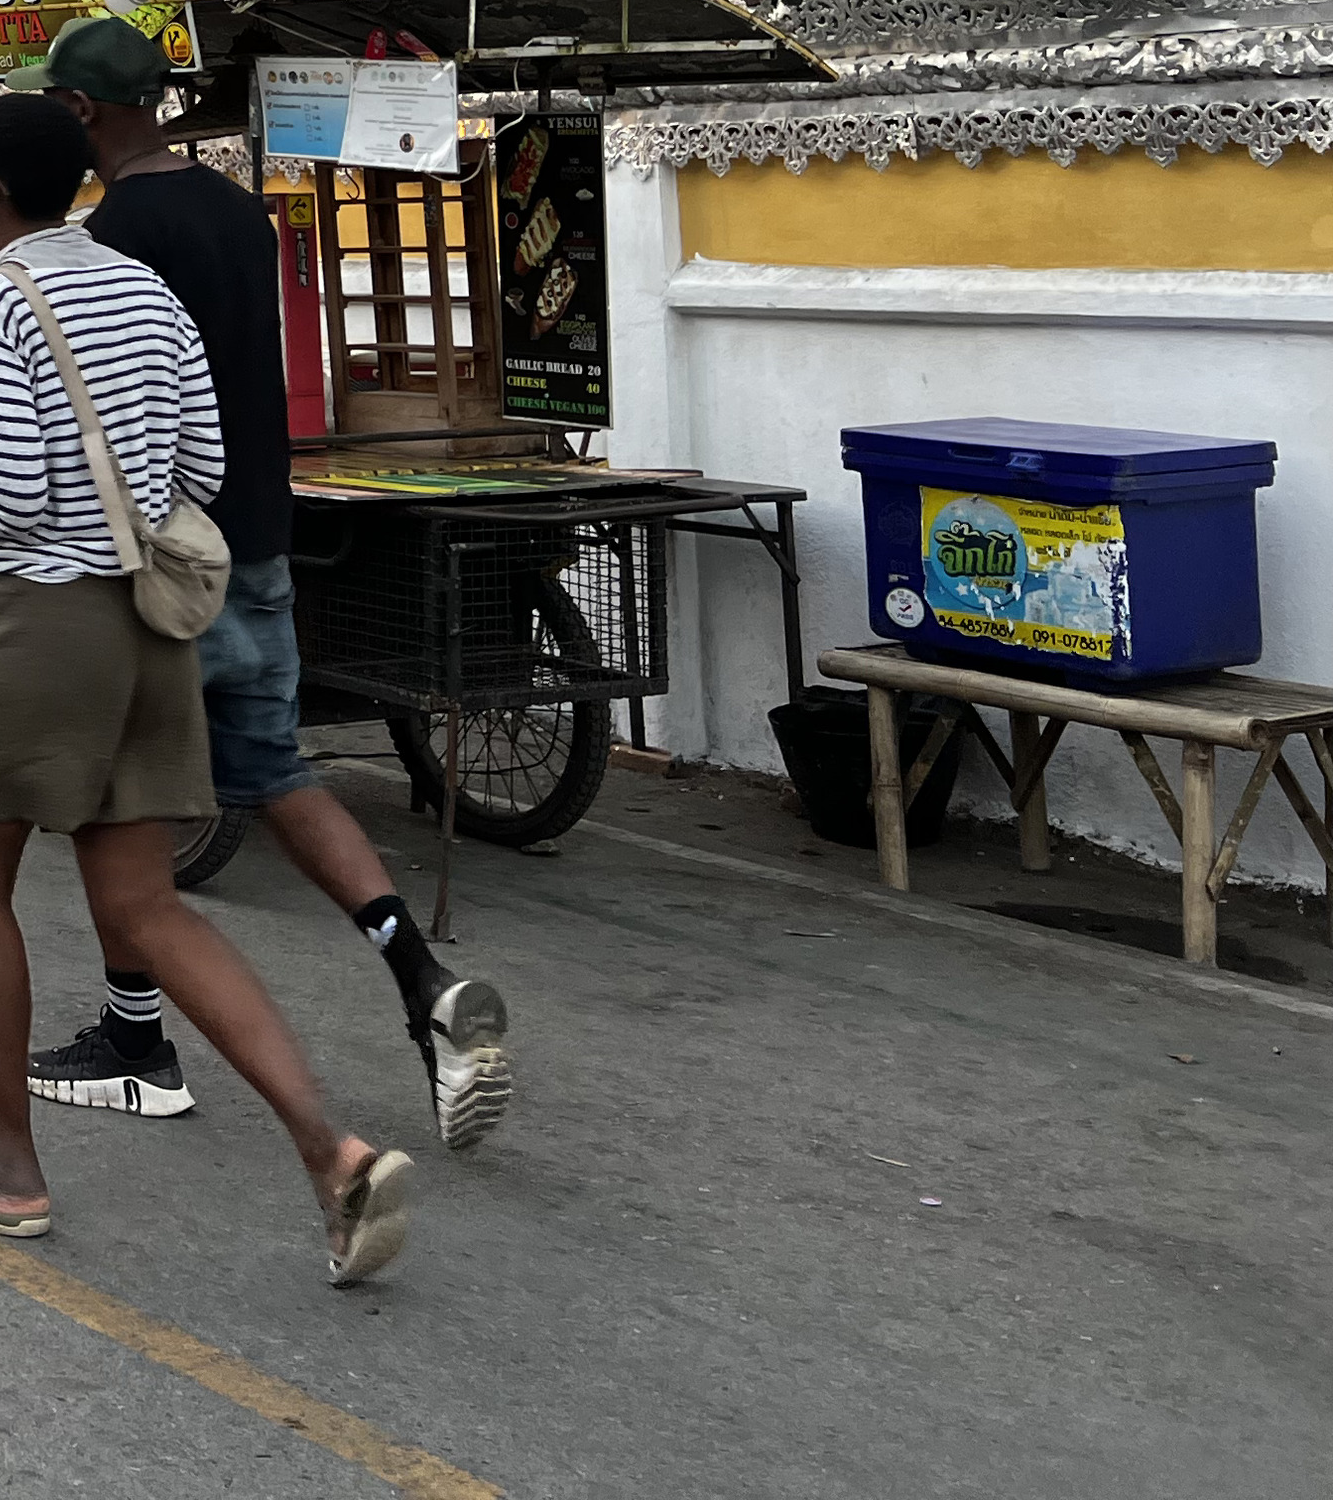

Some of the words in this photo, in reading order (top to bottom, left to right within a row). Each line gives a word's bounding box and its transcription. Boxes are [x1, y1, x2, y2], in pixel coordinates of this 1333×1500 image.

[547, 116, 598, 129] YENSUI
[505, 358, 545, 372] GARLIC
[546, 362, 583, 375] BREAD
[587, 365, 602, 377] 20
[506, 376, 547, 389] CHEESE
[586, 383, 600, 394] 40
[507, 397, 547, 411] CHEESE
[549, 401, 585, 415] VEGAN
[587, 404, 606, 416] 100
